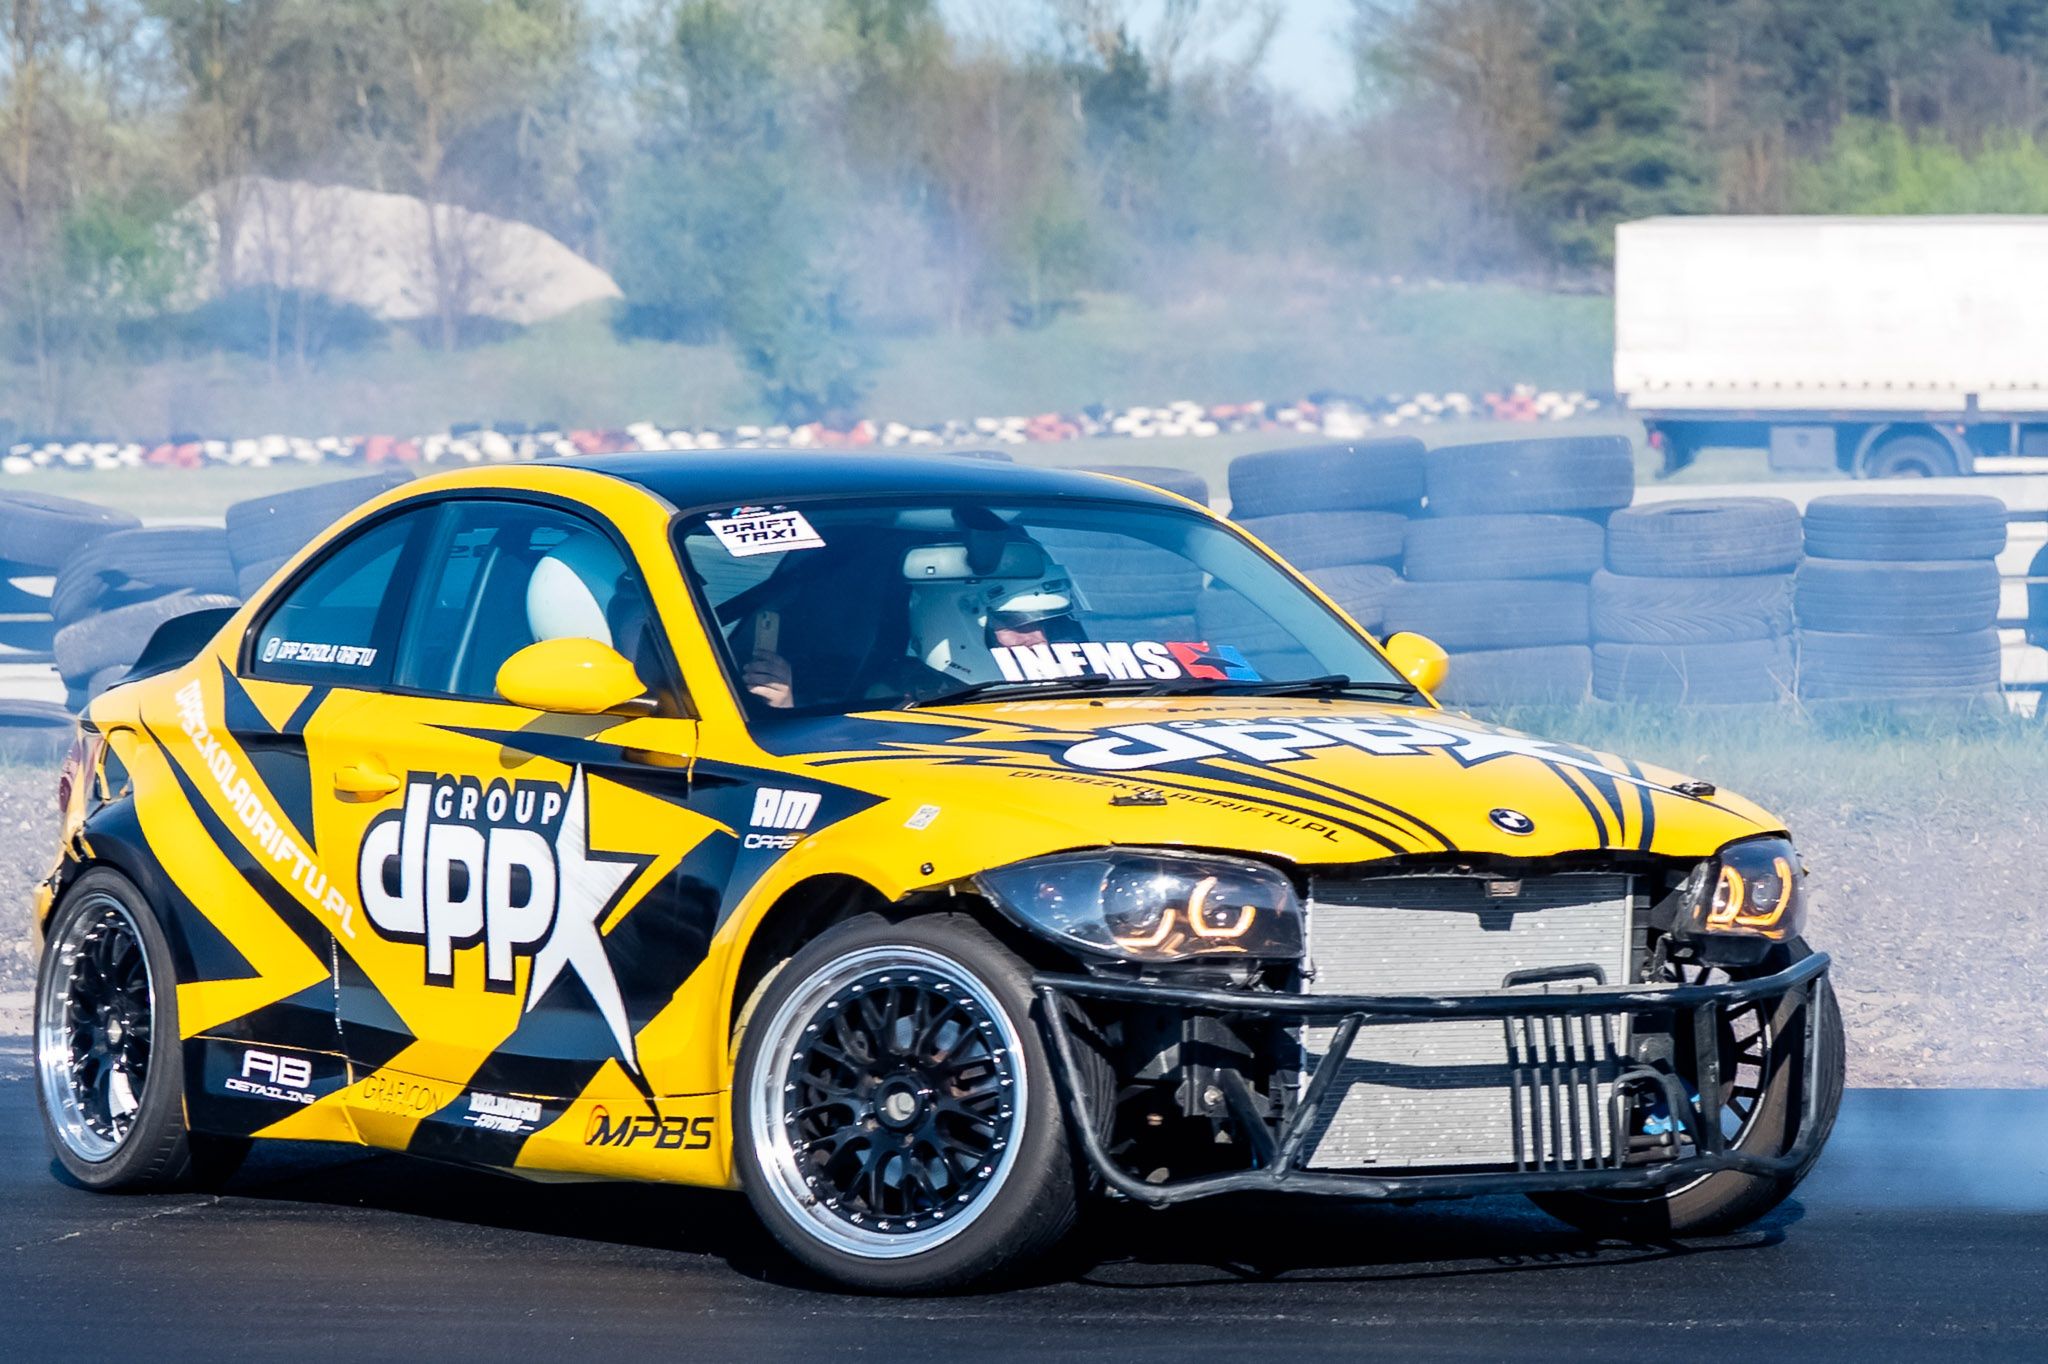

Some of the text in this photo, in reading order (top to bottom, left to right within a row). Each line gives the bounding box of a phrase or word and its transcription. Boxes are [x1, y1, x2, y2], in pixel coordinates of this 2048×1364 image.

[722, 518, 797, 534] DRIFT
[736, 528, 797, 543] TAXI
[434, 785, 562, 824] GROUP
[750, 787, 822, 830] AM
[241, 1049, 312, 1089] AB
[224, 1078, 317, 1105] DETAILING
[586, 1114, 715, 1150] MPBS
